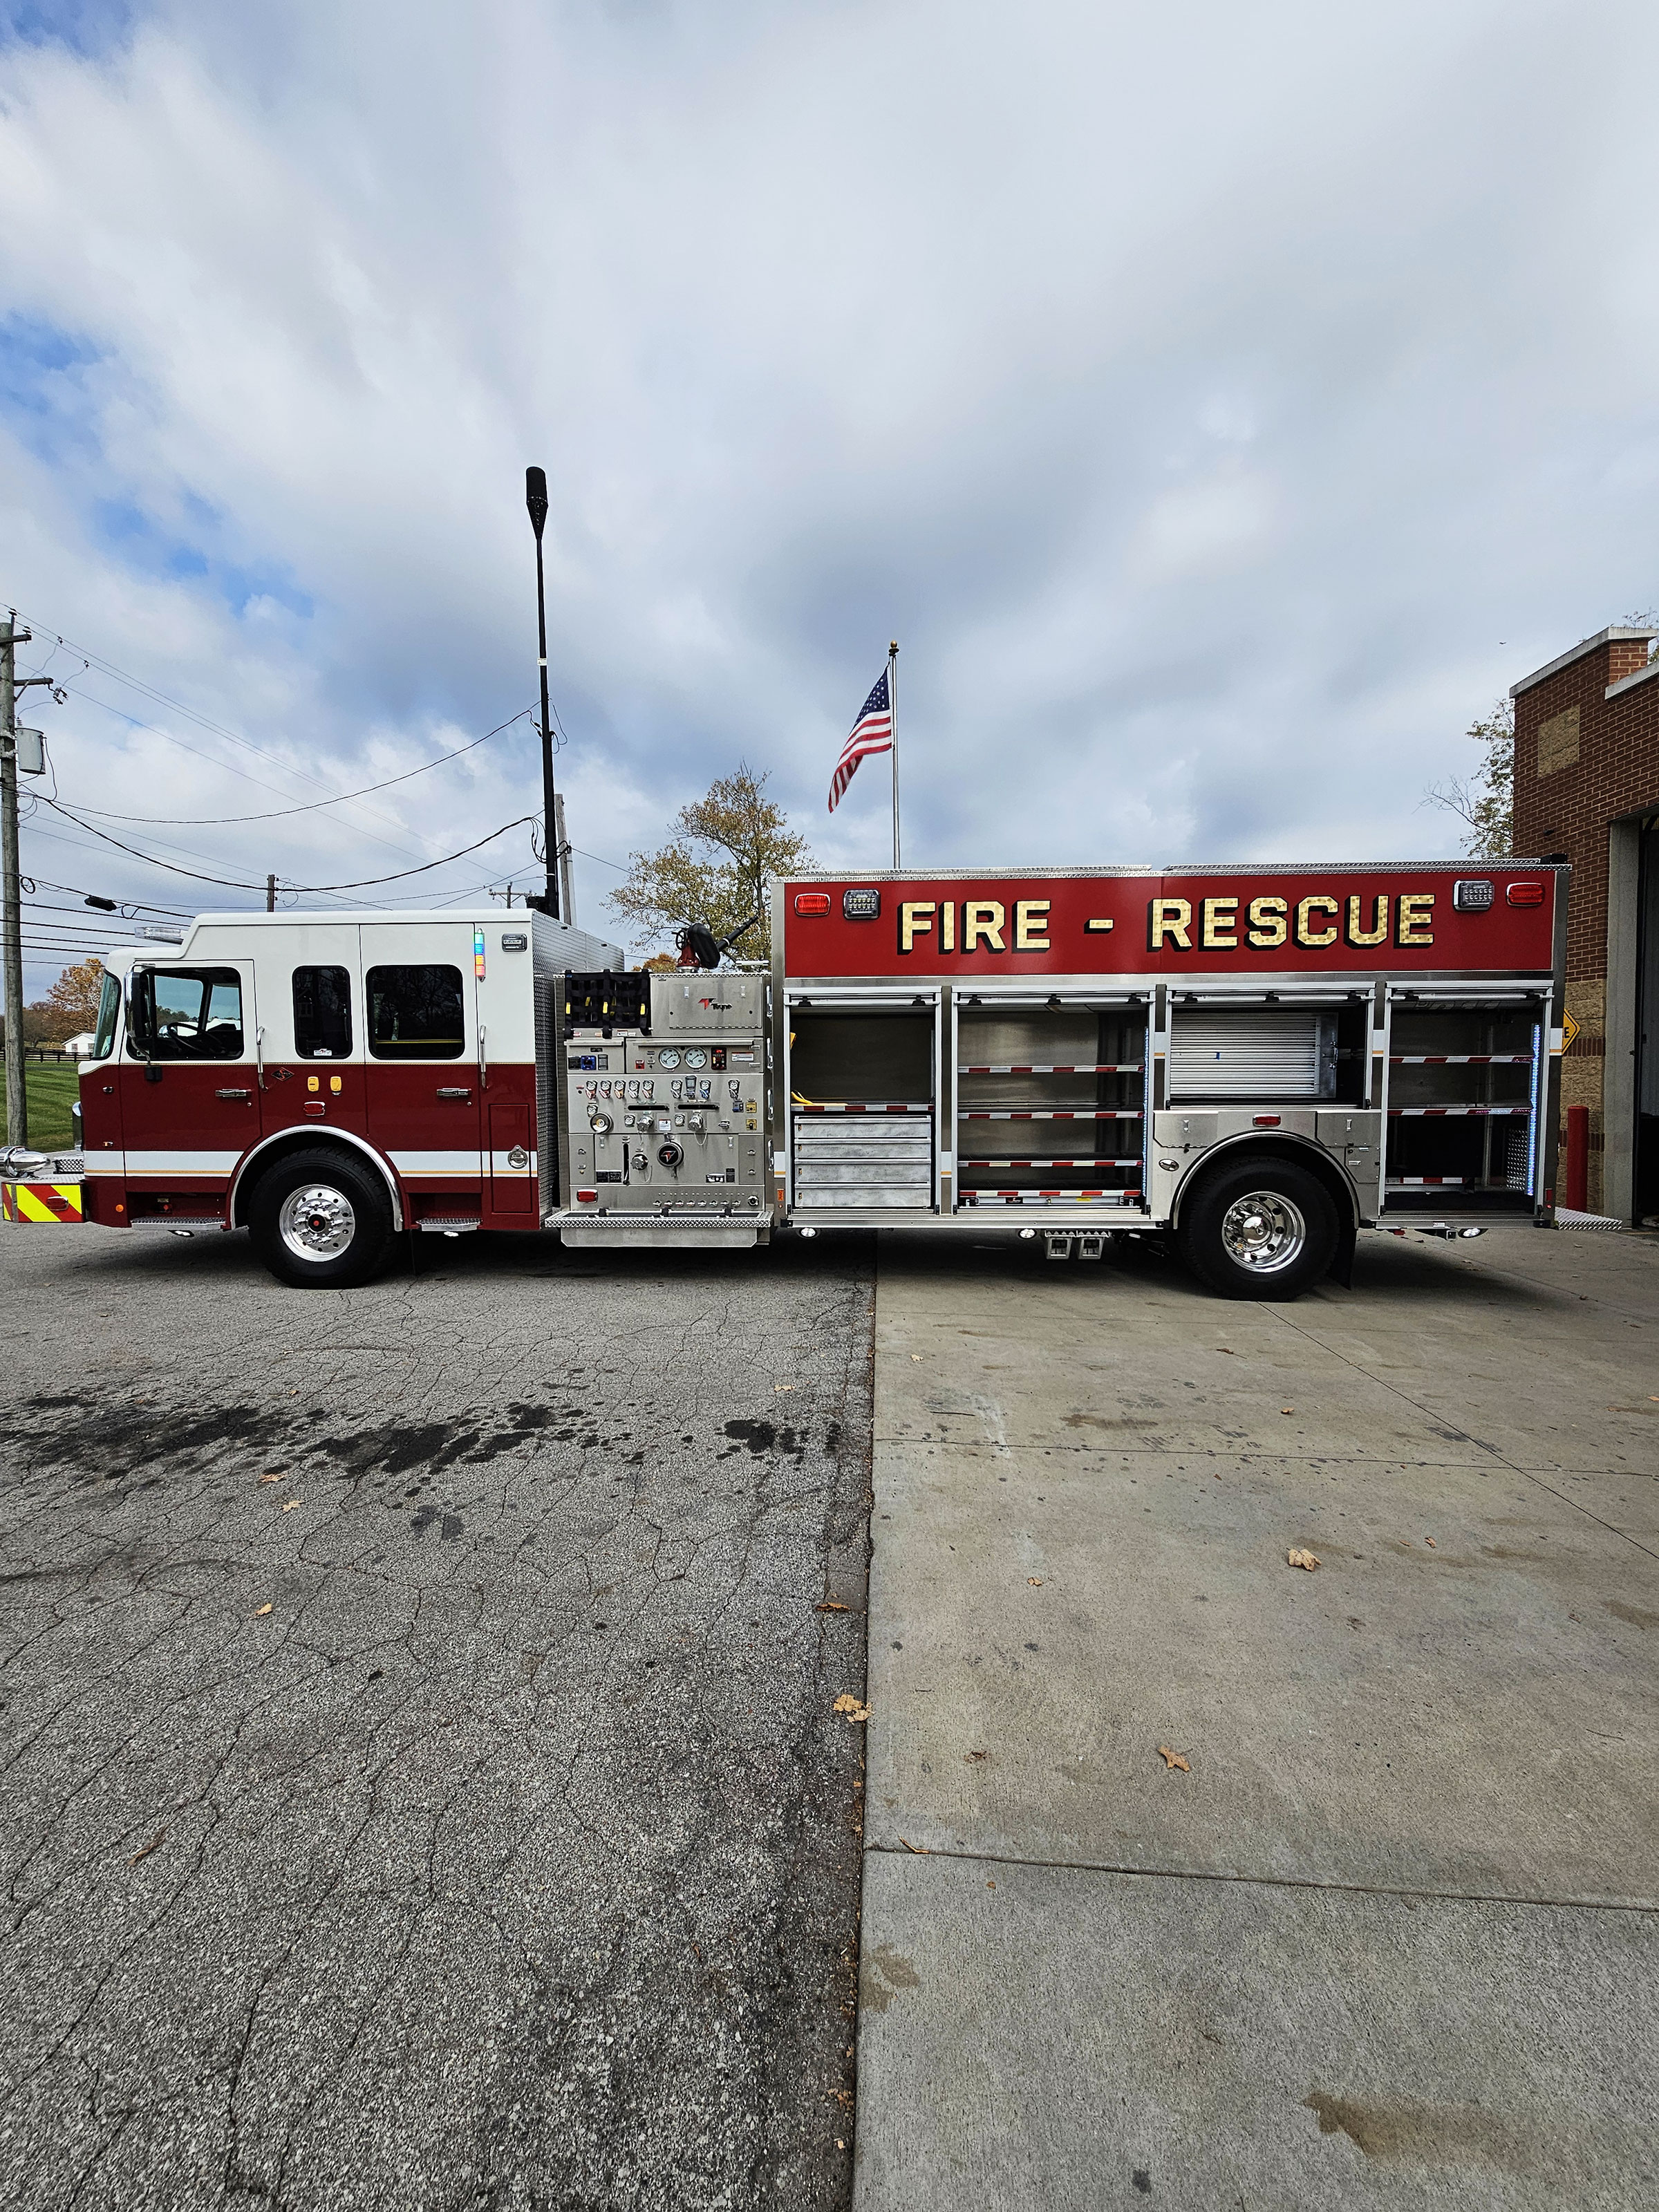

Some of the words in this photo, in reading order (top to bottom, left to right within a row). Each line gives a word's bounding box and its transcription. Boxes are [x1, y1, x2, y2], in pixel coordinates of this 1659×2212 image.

[898, 900, 1051, 954] FIRE
[1085, 919, 1114, 932] -
[1147, 894, 1435, 951] RESCUE
